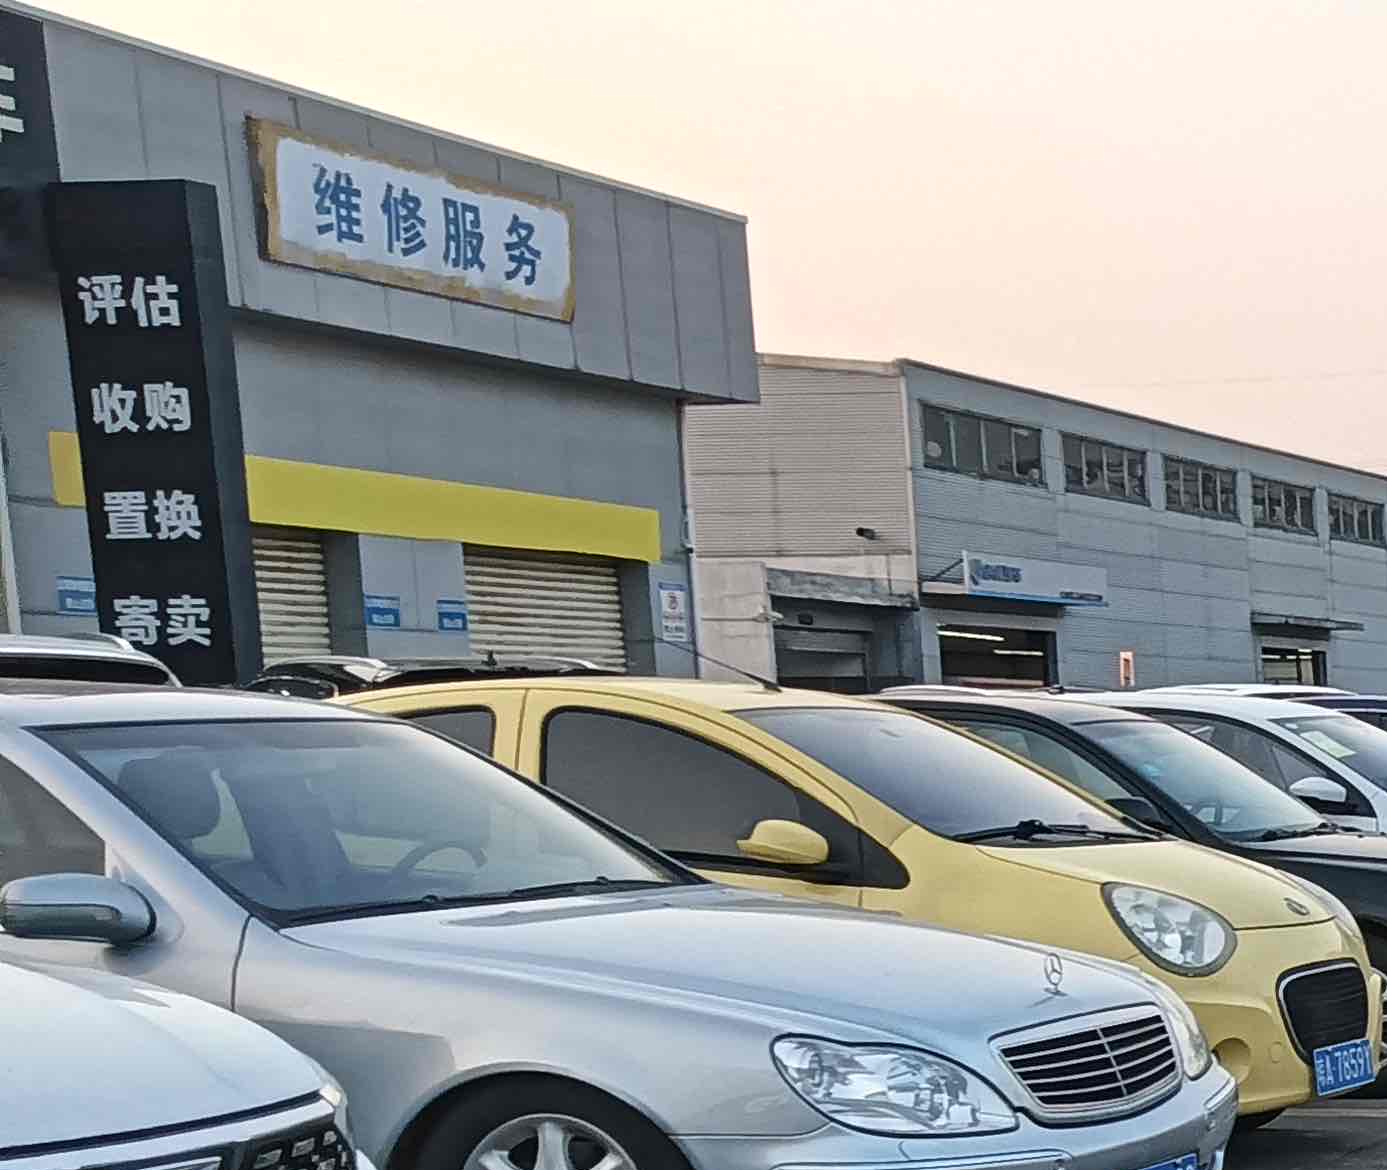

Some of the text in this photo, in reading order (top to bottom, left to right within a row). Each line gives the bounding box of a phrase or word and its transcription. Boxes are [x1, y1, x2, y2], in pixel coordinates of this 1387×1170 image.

[312, 163, 541, 285] 维修服务
[77, 274, 182, 327] 评估
[90, 382, 192, 433] 收购
[103, 490, 202, 540] 置换
[112, 595, 211, 647] 寄卖
